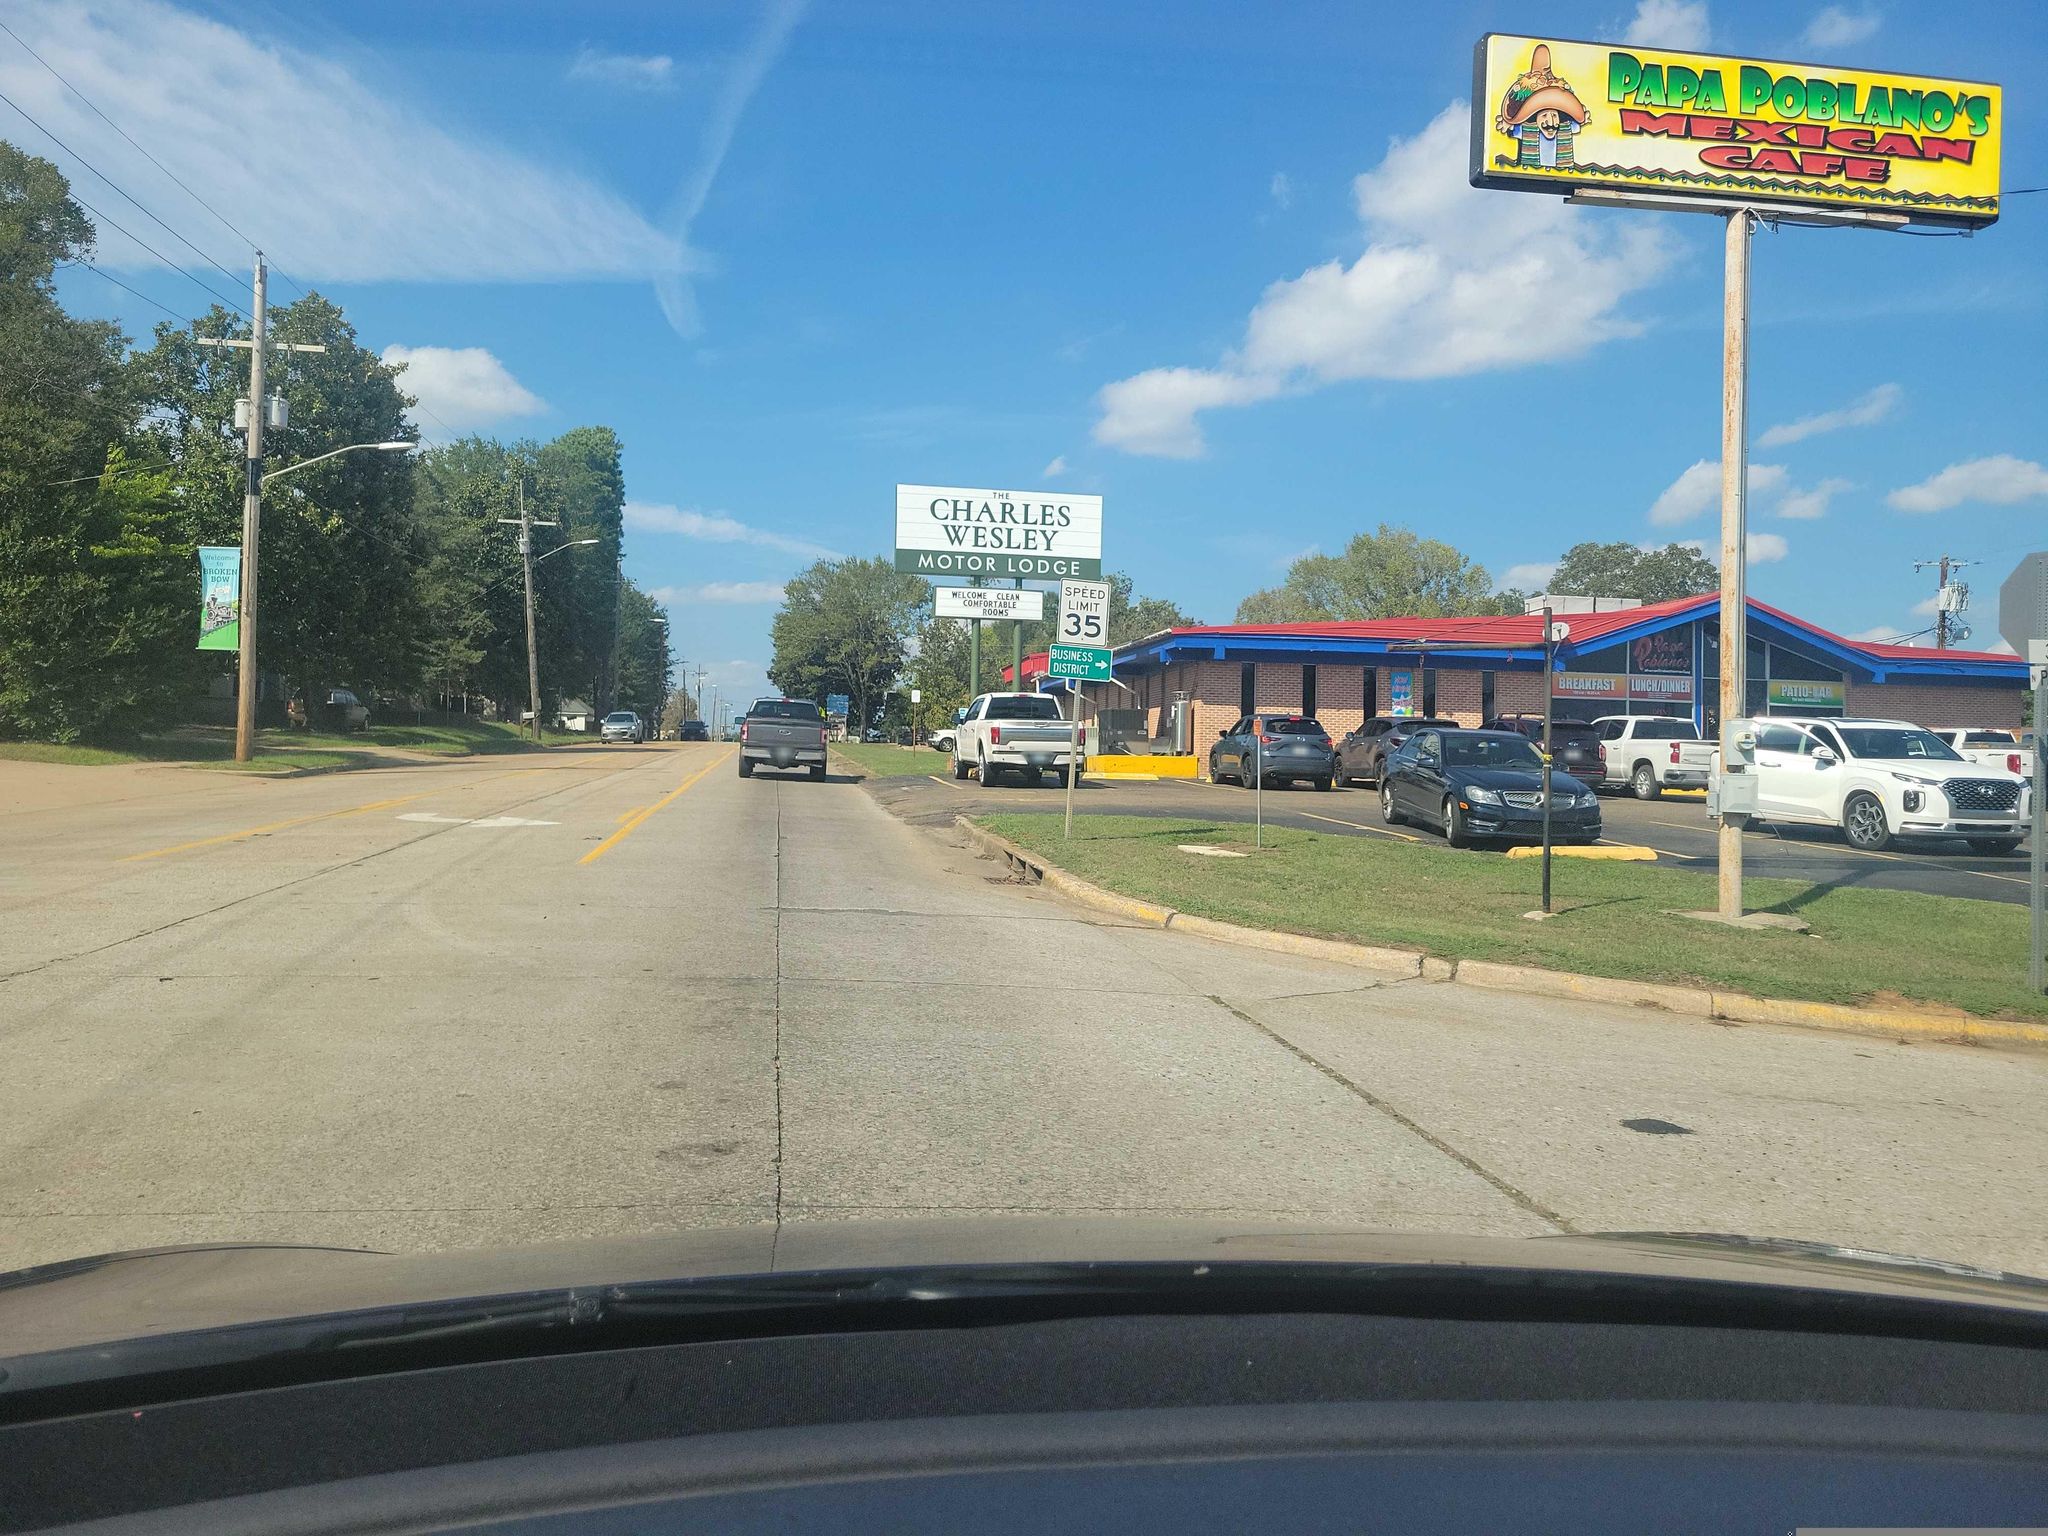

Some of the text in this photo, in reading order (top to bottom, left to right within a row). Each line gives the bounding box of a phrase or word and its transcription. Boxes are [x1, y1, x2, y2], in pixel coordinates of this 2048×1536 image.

[1608, 51, 1991, 137] PAPA POBLANO'S
[1619, 108, 1976, 164] MEXICAN
[1699, 145, 1892, 184] CAFE
[993, 492, 1010, 500] THE
[930, 498, 1070, 527] CHARLES
[942, 524, 1059, 551] WESLEY
[917, 553, 1080, 575] MOTOR LODGE
[203, 568, 238, 576] BROKEN
[952, 591, 1020, 601] WELCOME CLEAN
[1064, 587, 1106, 600] SPEED
[963, 599, 1017, 609] COMFORTABLE
[1068, 600, 1100, 612] LIMIT
[982, 608, 1009, 616] ROOMS
[1064, 613, 1101, 638] 35
[1051, 648, 1093, 662] BUSINESS
[1053, 662, 1090, 675] DISTRICT
[1558, 678, 1616, 691] BREAKFAST
[1631, 679, 1691, 693] LUNCH/DINNER
